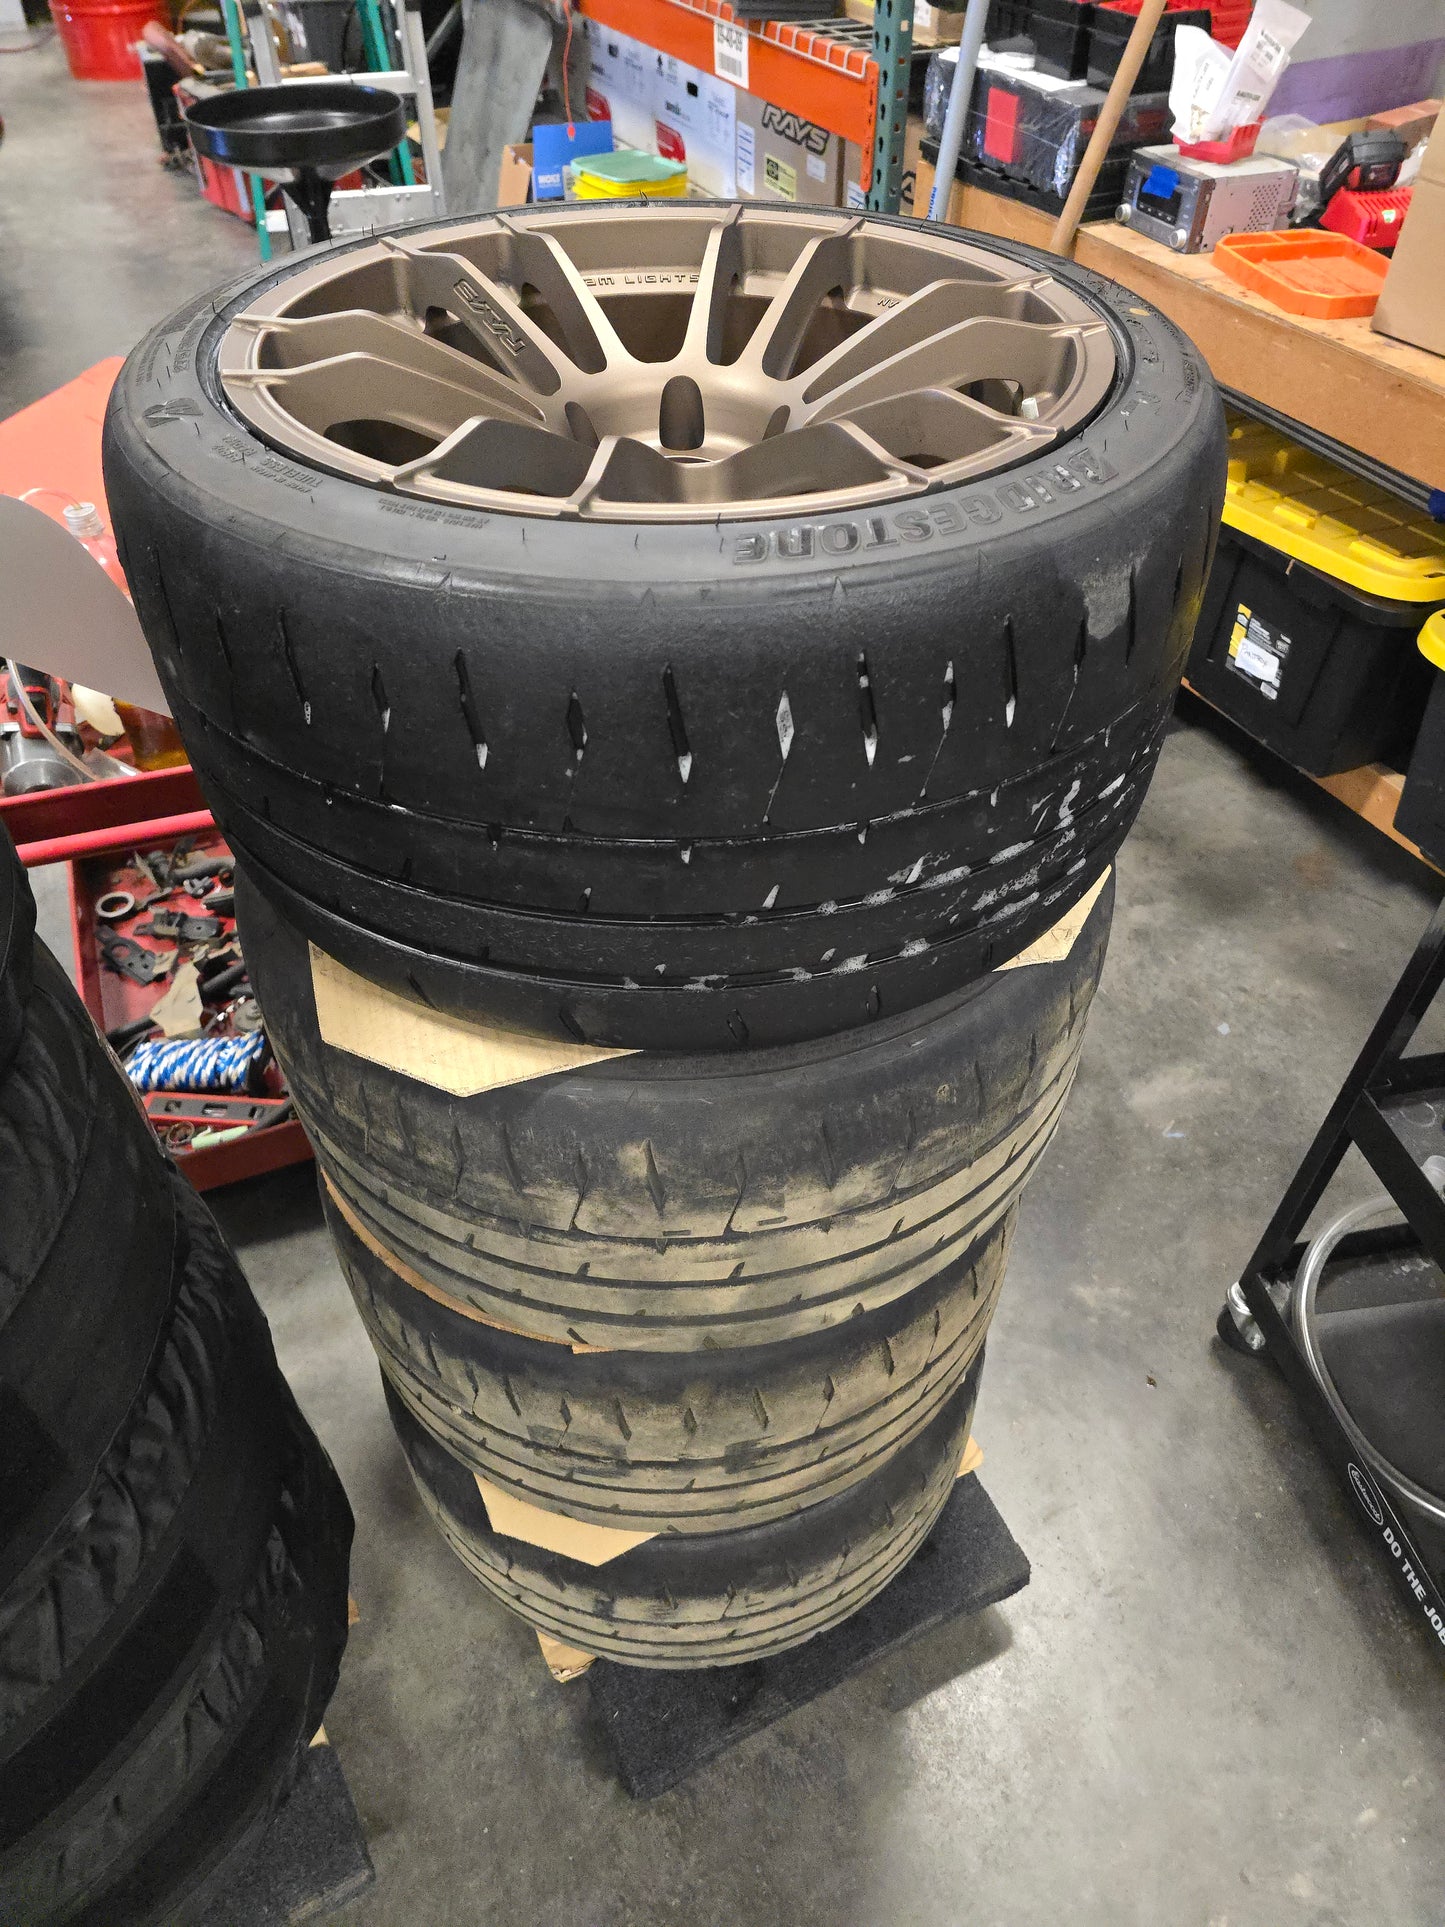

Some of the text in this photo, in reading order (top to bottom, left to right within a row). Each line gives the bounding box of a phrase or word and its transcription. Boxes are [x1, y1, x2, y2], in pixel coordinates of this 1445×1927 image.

[762, 102, 830, 155] RAYS
[625, 273, 700, 285] LIGHTS
[453, 279, 526, 356] RAYS
[732, 447, 1119, 565] BRIDGESTONE
[1351, 1469, 1382, 1521] Eastwood
[1382, 1526, 1402, 1558] DO
[1401, 1557, 1427, 1602] THE
